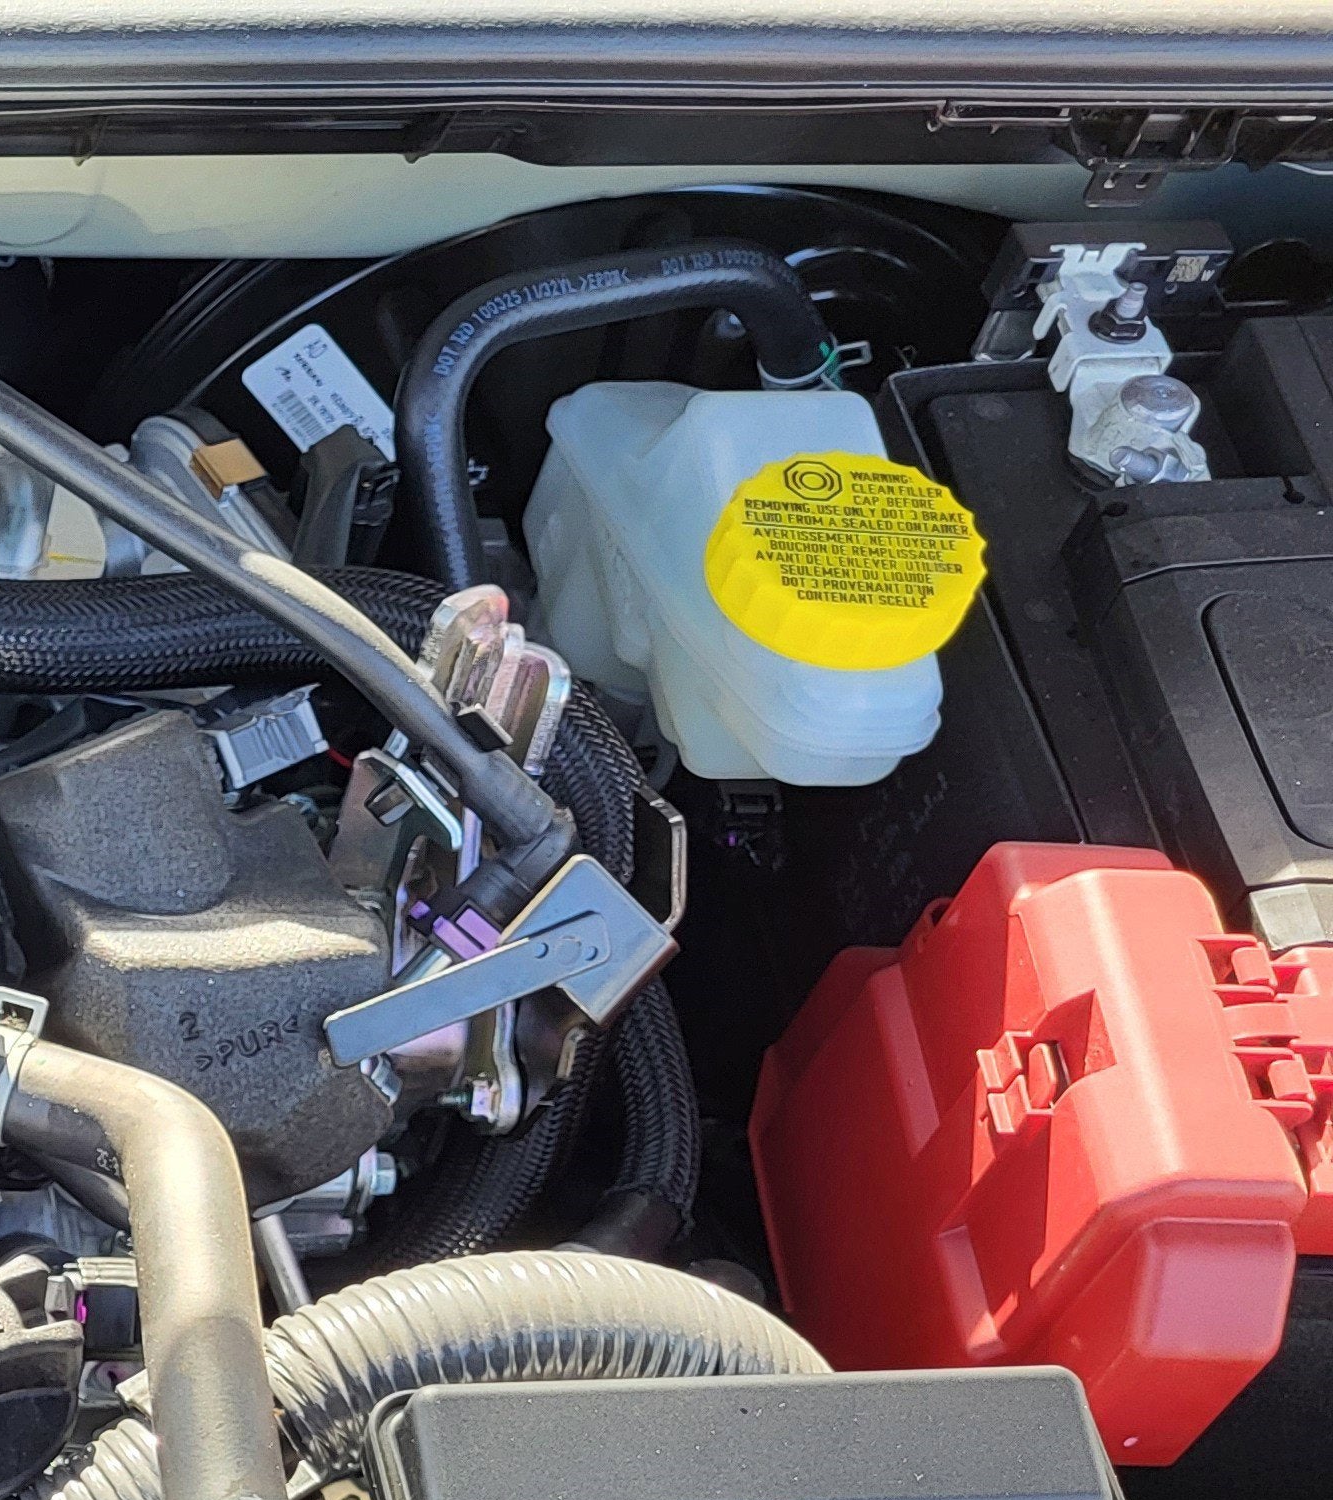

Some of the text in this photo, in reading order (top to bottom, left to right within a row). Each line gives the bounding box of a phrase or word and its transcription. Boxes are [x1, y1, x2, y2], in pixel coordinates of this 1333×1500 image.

[851, 483, 943, 498] CLEAN FILLER
[853, 495, 936, 510] CAP BEFORE
[745, 510, 783, 523] FLUID
[788, 513, 824, 526] FROM
[828, 516, 838, 527] A
[841, 517, 893, 531] SEALED
[817, 504, 841, 516] USE
[843, 506, 876, 518] ONLY
[881, 508, 906, 520] DOT
[910, 510, 918, 521] 3
[922, 510, 965, 524] BRAKE
[770, 540, 944, 562] BOUCHON DE REMPLISSAGE
[869, 535, 937, 550] NETTOYER
[940, 540, 956, 551] LE
[756, 550, 801, 563] AVANT
[805, 554, 823, 565] DE
[905, 560, 963, 574] UTILISER
[780, 563, 932, 584] SEULEMENT DU LIQUIDE
[781, 576, 806, 588] DOT
[811, 578, 819, 589] 3
[822, 579, 900, 594] PROVENANT
[797, 589, 874, 605] CONTENANT
